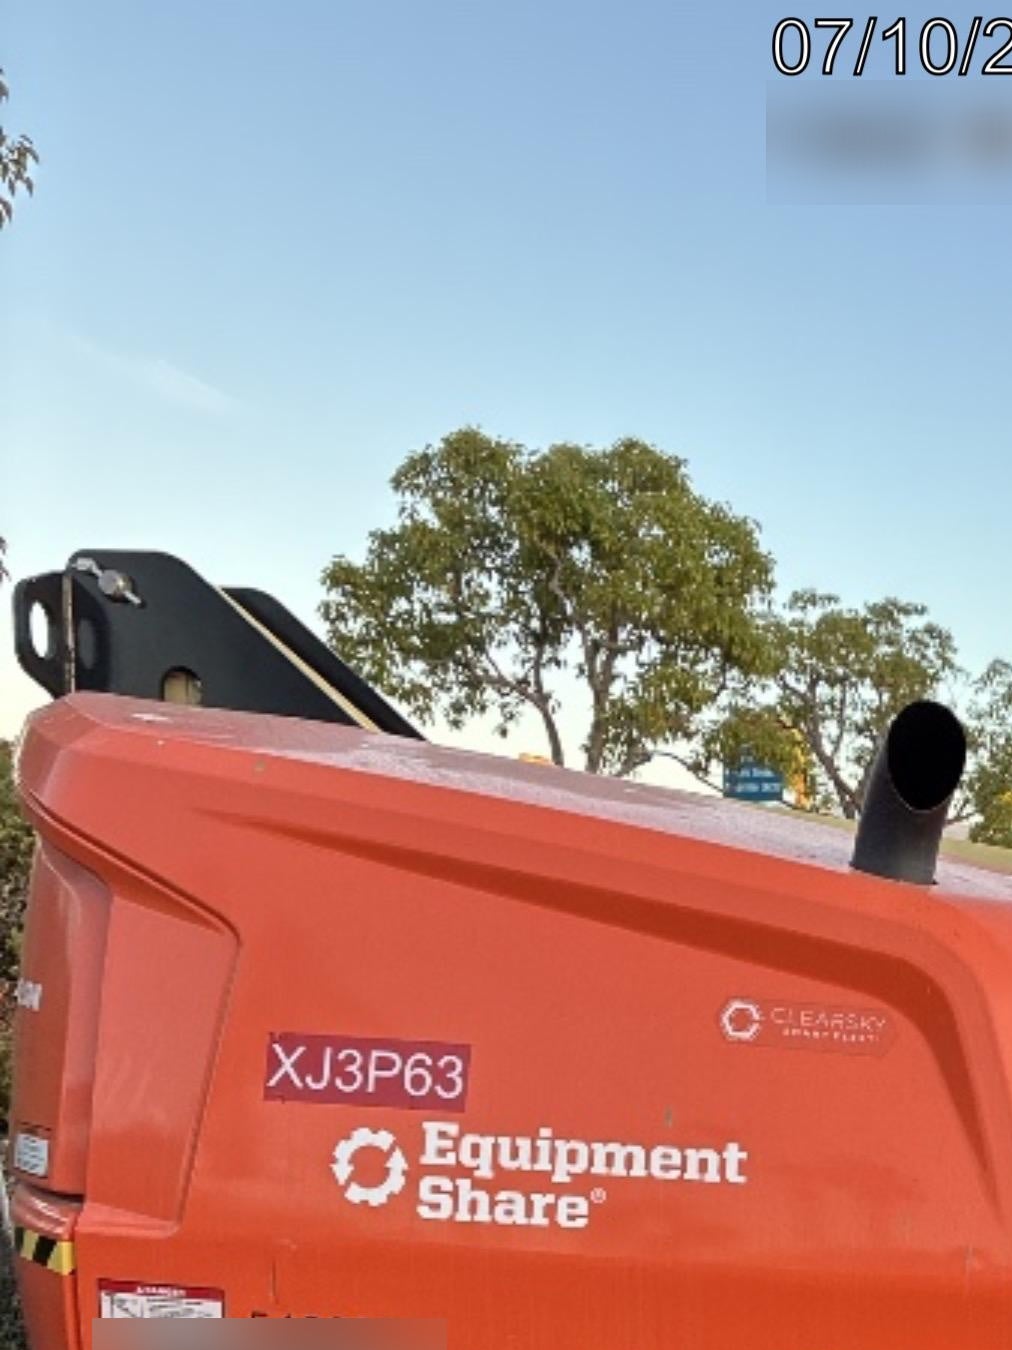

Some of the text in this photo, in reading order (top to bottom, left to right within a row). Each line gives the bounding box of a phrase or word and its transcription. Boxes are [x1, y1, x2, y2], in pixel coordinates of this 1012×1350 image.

[770, 1007, 886, 1032] CLEARSKY
[266, 1043, 464, 1099] XJ3P63
[419, 1121, 748, 1183] Equipment
